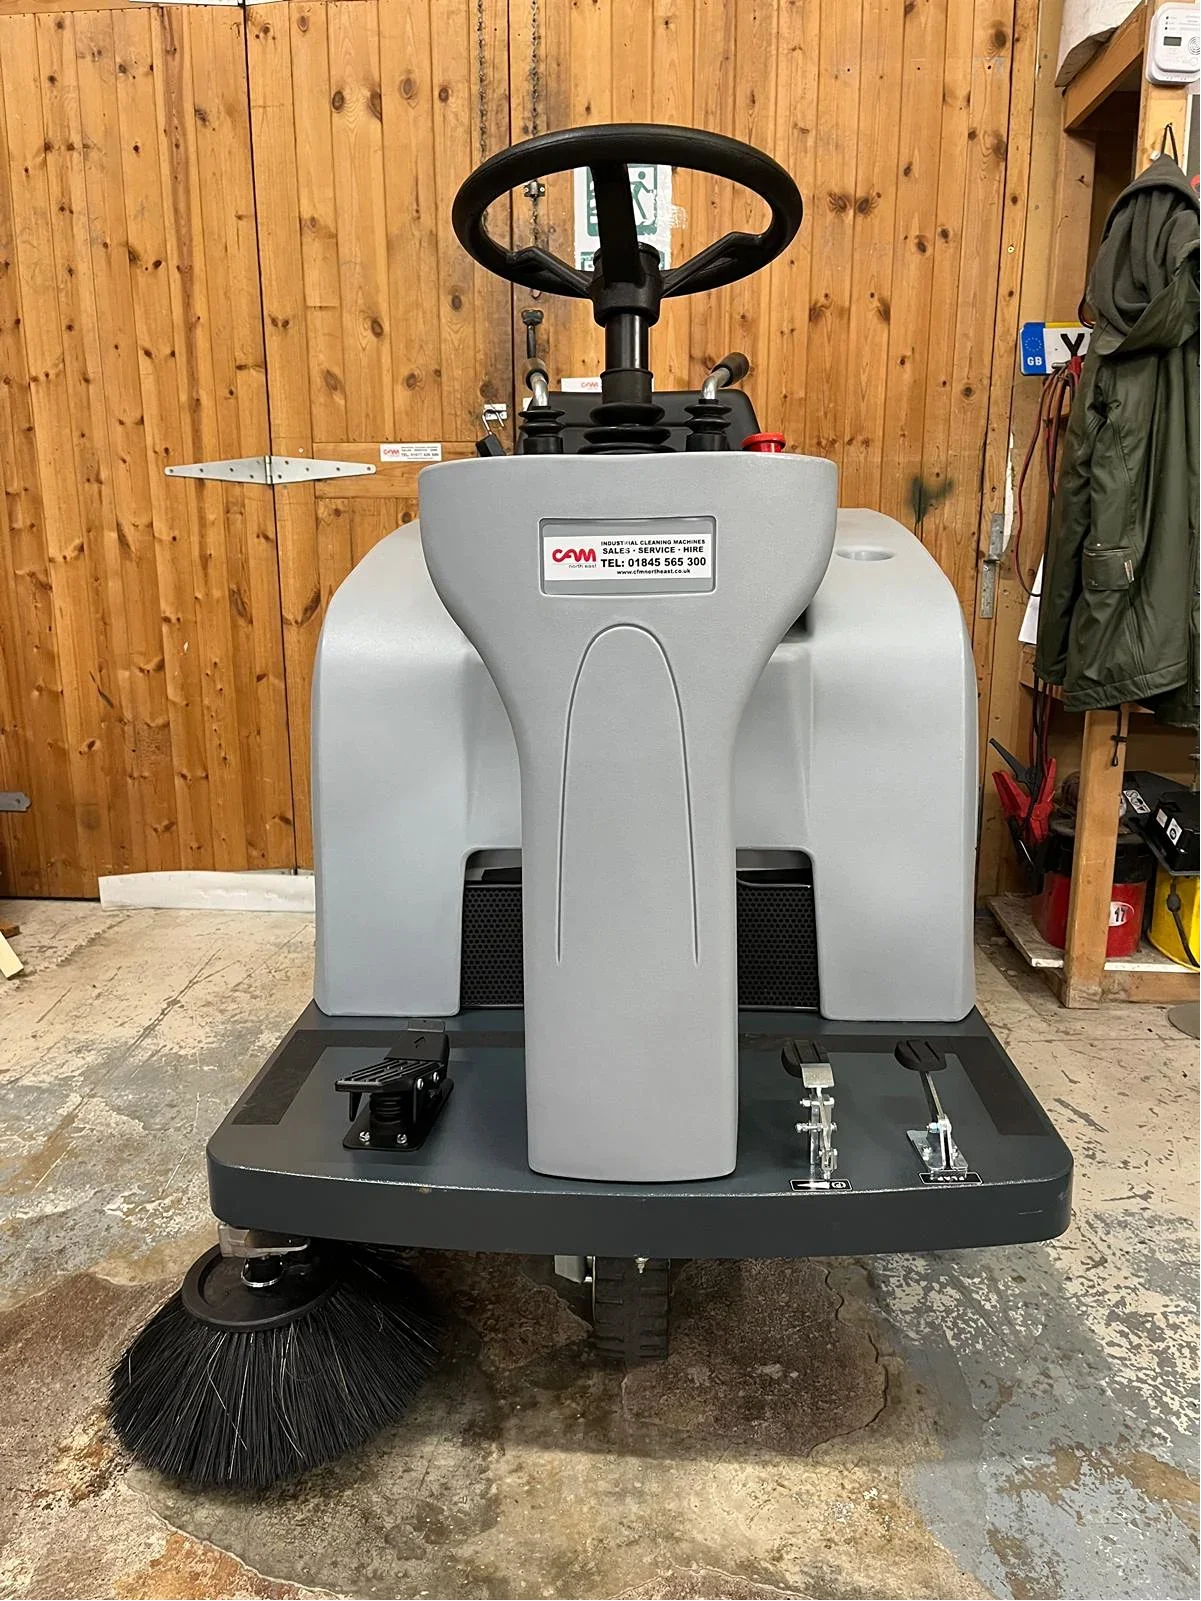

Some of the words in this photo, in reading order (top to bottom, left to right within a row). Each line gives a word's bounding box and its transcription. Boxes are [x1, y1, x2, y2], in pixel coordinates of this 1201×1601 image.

[1060, 332, 1092, 358] Y
[1027, 356, 1042, 366] GB
[638, 546, 675, 554] SERVICE
[601, 558, 625, 568] TEL:
[628, 557, 661, 567] 01845
[664, 557, 684, 567] 565
[687, 556, 706, 566] 300
